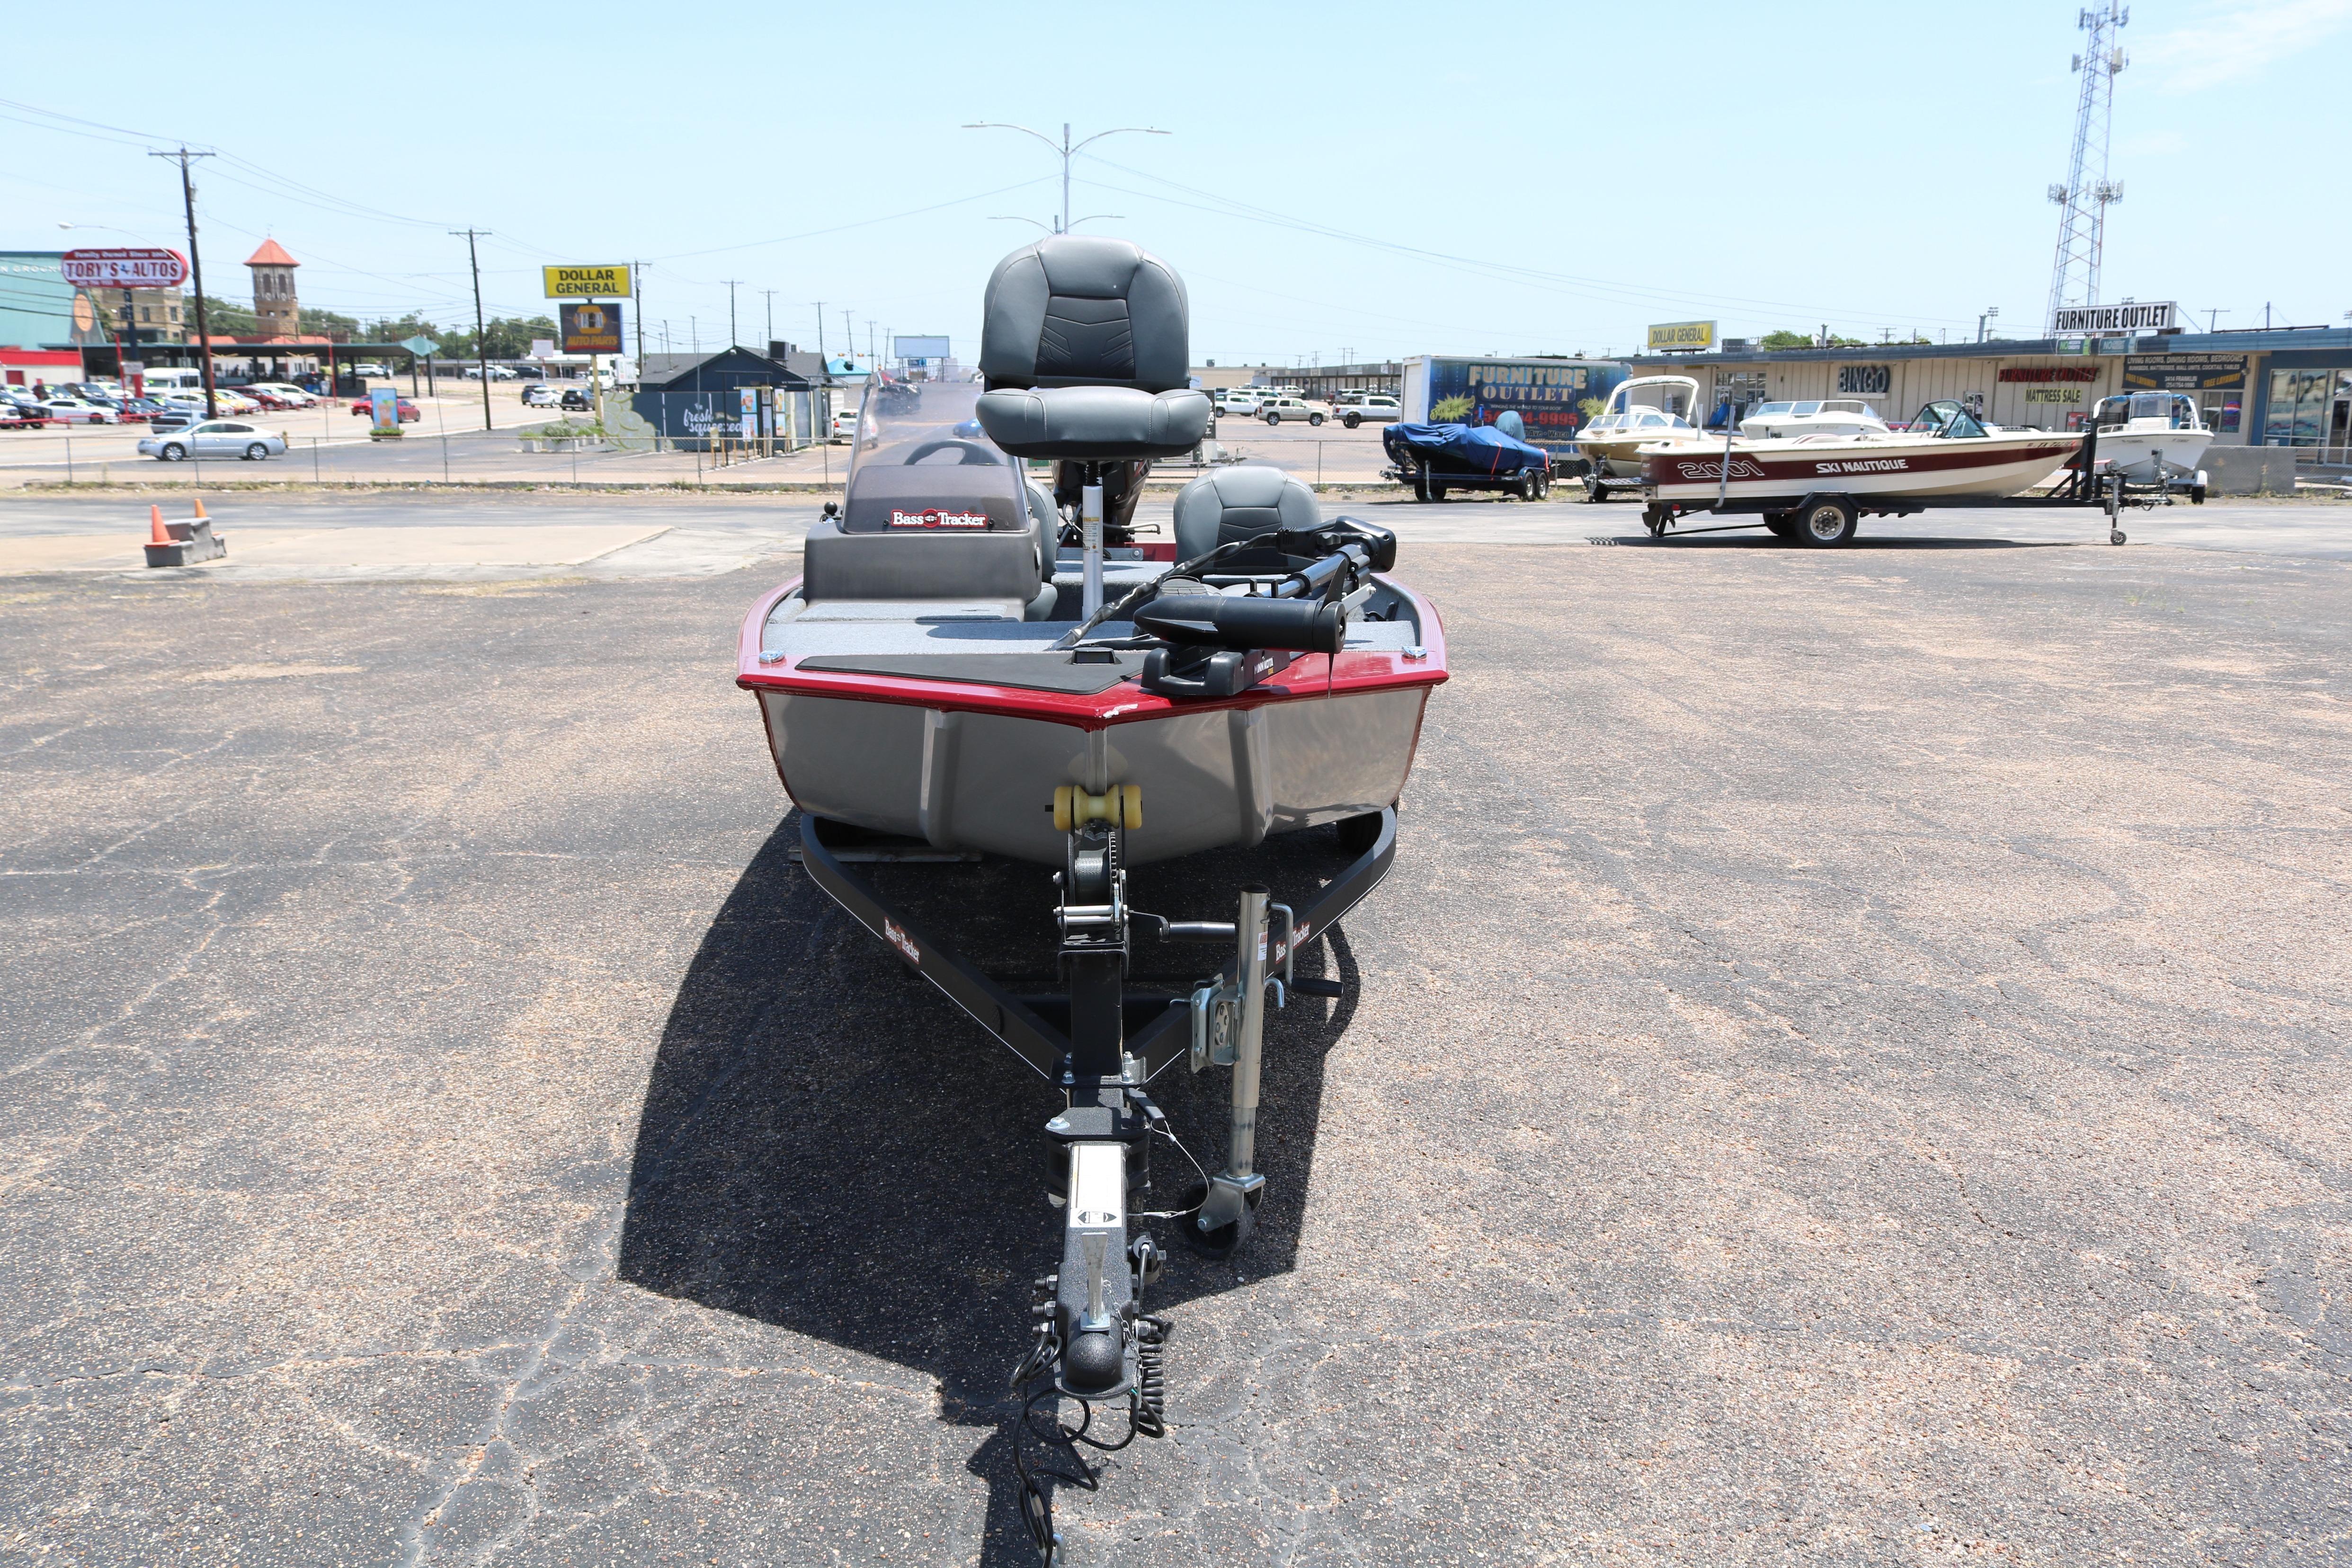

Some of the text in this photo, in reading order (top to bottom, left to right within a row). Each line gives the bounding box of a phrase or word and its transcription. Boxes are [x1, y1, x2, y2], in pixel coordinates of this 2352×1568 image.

[66, 262, 178, 277] TOBY'S AUTOS
[559, 270, 615, 280] DOLLAR
[556, 282, 619, 294] GENERAL
[2056, 305, 2168, 330] FURNITURE OUTLET
[567, 336, 617, 345] AUTO PARTS
[1653, 327, 1704, 343] DOLLAR GENERAL
[2060, 340, 2069, 350] NO
[2103, 340, 2112, 349] NO
[1469, 365, 1586, 389] FURNITURE
[1837, 366, 1889, 393] BINGO
[1998, 367, 2100, 382] FURNITURE OUTLET
[2204, 379, 2216, 387] FREE
[1483, 386, 1572, 401] OUTLET
[2025, 389, 2081, 403] MATTRESS SALE
[683, 409, 714, 427] fresh
[1677, 460, 1765, 478] 2001
[1816, 459, 1908, 473] SKI NAUTIQUE
[893, 511, 986, 526] Bass Tracker
[1254, 657, 1274, 675] MINN KOTA
[885, 919, 919, 962] Bass Tracker
[1276, 944, 1287, 962] Bas
[1293, 924, 1310, 947] Tracker
